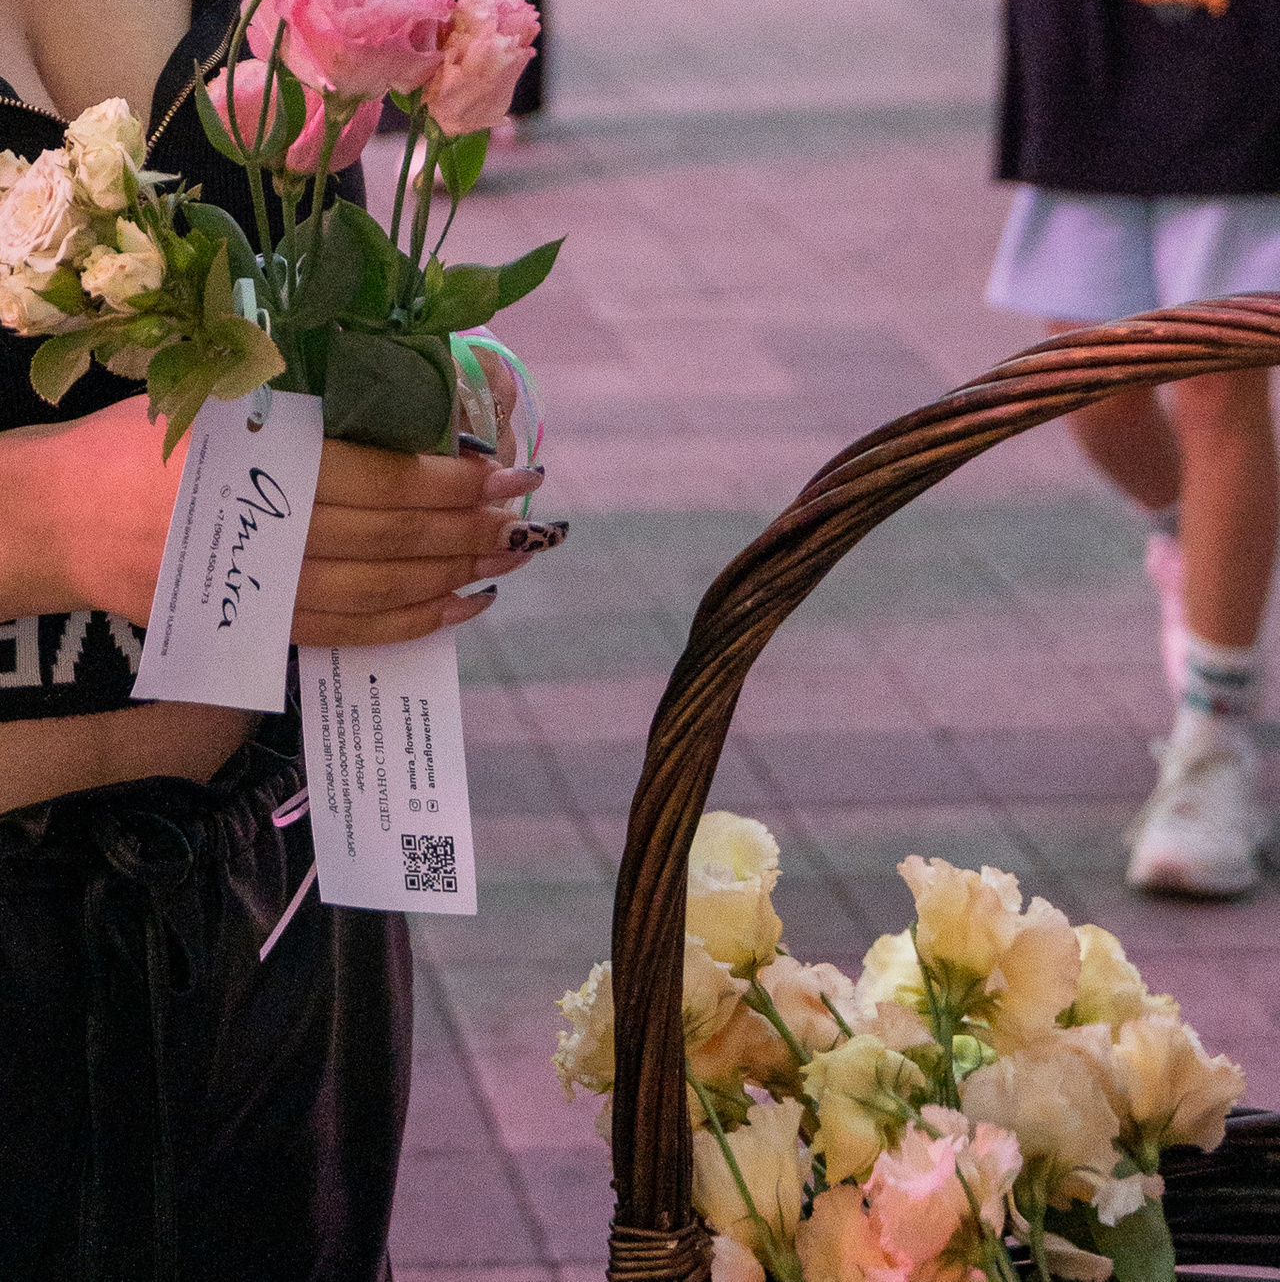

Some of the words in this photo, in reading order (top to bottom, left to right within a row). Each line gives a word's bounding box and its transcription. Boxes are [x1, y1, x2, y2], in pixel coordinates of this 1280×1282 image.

[210, 523, 223, 550] (909)
[217, 467, 291, 632] Amira
[201, 552, 217, 605] 450-33-73
[318, 678, 329, 713] ШАРОВ
[322, 714, 330, 723] И
[369, 687, 385, 754] ЛЮБОВЬЮ
[322, 724, 334, 761] ЦВЕТОВ
[335, 710, 349, 777] ОФОРМЛЕНИЕ
[350, 705, 362, 751] ФОТОЗОН
[400, 696, 418, 790] amira_flowers.krd
[419, 699, 436, 788] amiraflowerskrd
[341, 778, 350, 787] И
[375, 756, 386, 765] С
[343, 788, 356, 857] ОРГАНИЗАЦИЯ
[376, 768, 392, 832] СДЕЛАНО
